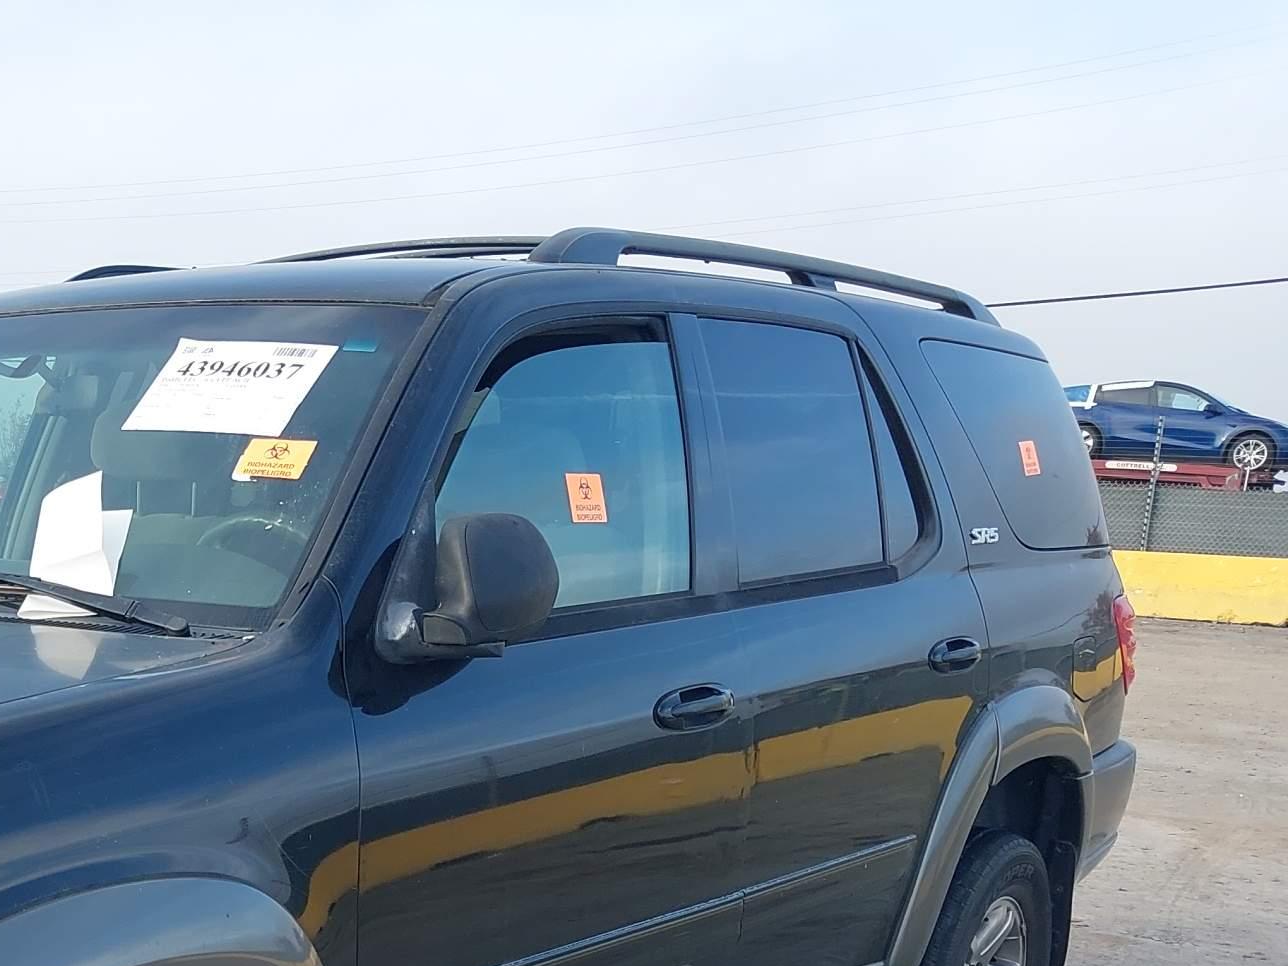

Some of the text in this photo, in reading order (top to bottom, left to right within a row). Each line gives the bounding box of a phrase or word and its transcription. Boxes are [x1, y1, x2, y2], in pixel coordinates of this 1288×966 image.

[176, 359, 306, 380] 43946037
[247, 461, 295, 470] BIOHAZARD
[971, 527, 1000, 545] SR5
